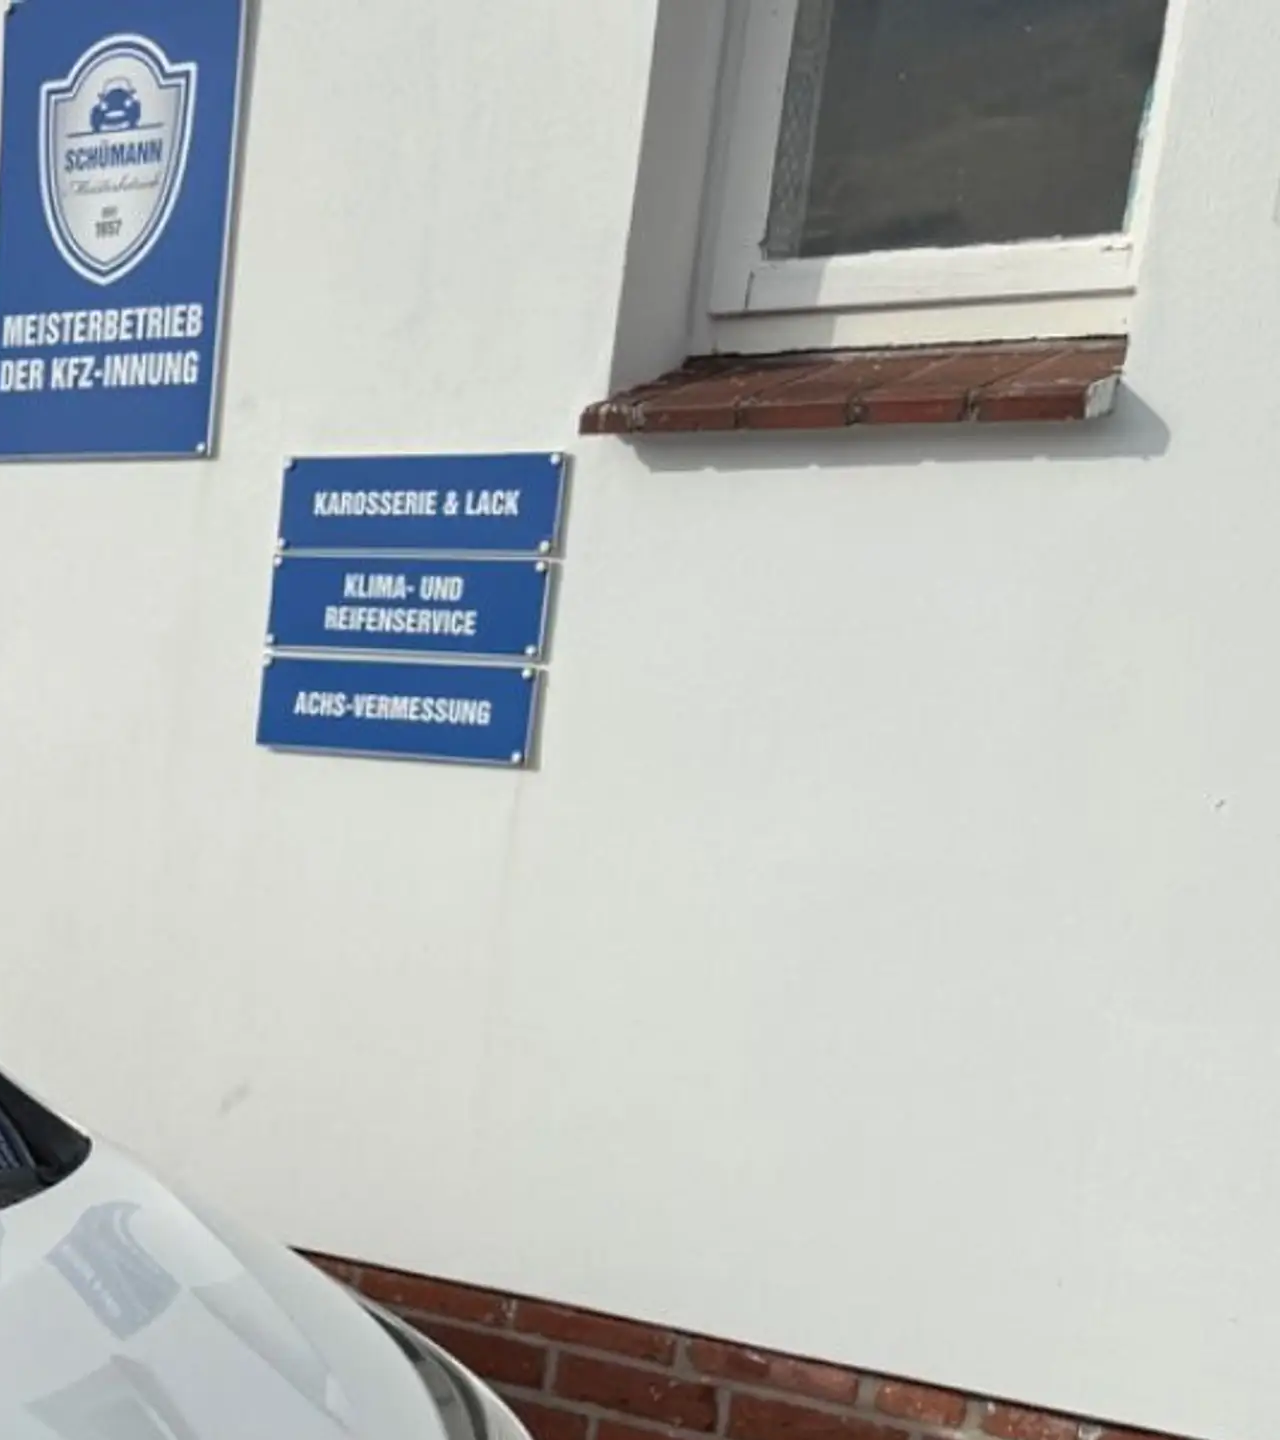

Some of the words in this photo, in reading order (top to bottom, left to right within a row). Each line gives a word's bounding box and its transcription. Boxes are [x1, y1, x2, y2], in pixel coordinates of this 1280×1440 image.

[64, 138, 163, 173] SCHÜMANN
[2, 304, 204, 348] MEISTERBETRIEB
[0, 357, 42, 391] DER
[51, 351, 199, 389] KFZ-INNUNG
[313, 490, 438, 516] KAROSSERIE
[444, 490, 460, 515] &
[464, 489, 521, 516] LACK
[343, 572, 415, 601] KLIMA-
[420, 575, 464, 601] UND
[323, 606, 477, 636] REIFENSERVICE
[293, 690, 492, 726] ACHS-VERMESSUNG
